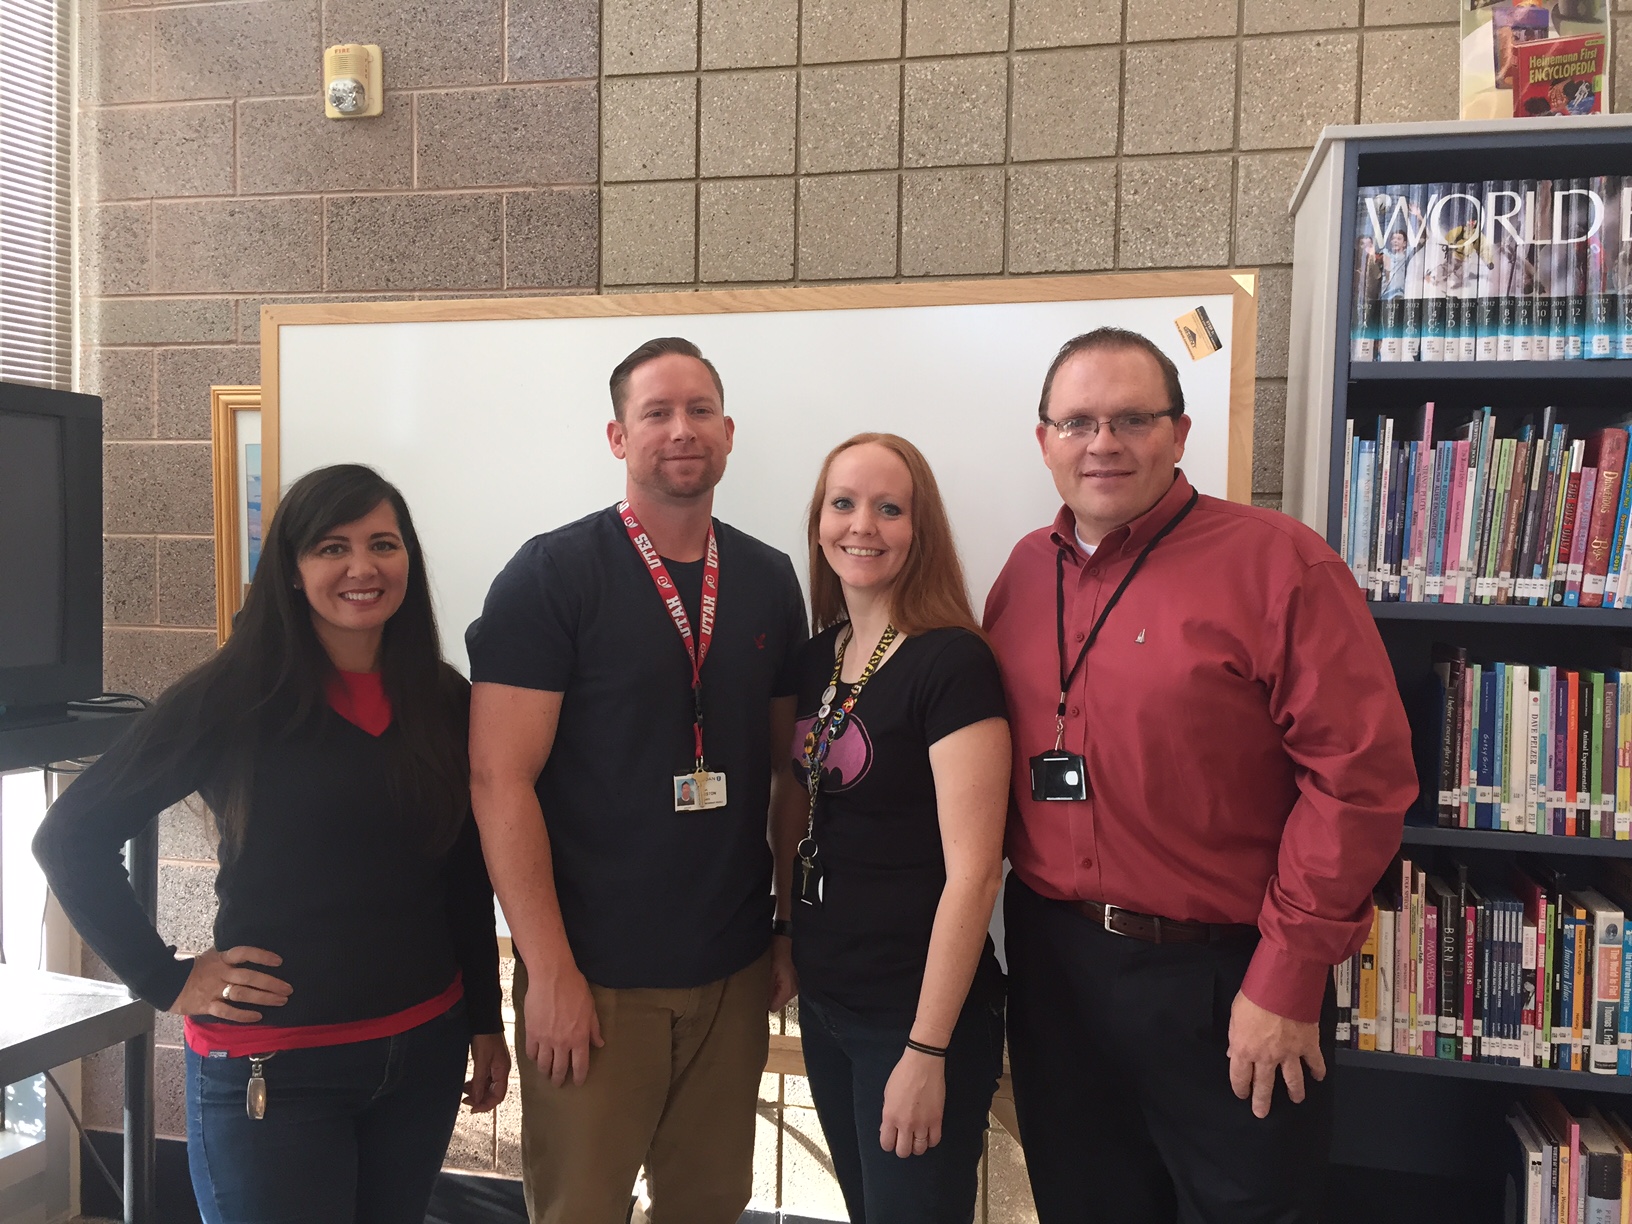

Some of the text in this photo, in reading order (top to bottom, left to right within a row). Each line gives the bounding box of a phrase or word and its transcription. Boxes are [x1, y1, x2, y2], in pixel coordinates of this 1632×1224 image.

[1530, 47, 1598, 68] Heinemann First
[1529, 60, 1596, 84] ENCYCLOPEDIA
[1364, 190, 1605, 249] WORLD
[1450, 311, 1454, 320] 5
[1485, 310, 1490, 318] 7
[1522, 309, 1528, 317] 9
[1536, 309, 1546, 317] 10
[1571, 308, 1580, 316] 12
[1597, 307, 1606, 315] 13
[1388, 320, 1394, 328] B
[1448, 320, 1456, 328] D
[1503, 318, 1510, 326] G
[1584, 480, 1594, 500] WHEN
[1511, 499, 1519, 518] Pioneers
[1582, 500, 1591, 510] DO
[1560, 482, 1578, 552] FOR BOYS ONLY
[1580, 512, 1590, 527] FISH
[1361, 530, 1368, 541] OF
[1616, 534, 1624, 554] Edition
[634, 532, 662, 570] UTES
[707, 535, 718, 568] UTES
[666, 596, 691, 638] UTAH
[702, 594, 716, 636] UTAH
[1446, 700, 1455, 718] before
[1605, 691, 1614, 729] Euthanasia
[1531, 714, 1539, 734] DAVE
[1481, 733, 1490, 755] Gutsy
[1530, 735, 1538, 765] PELZER
[1466, 937, 1474, 960] SILLY
[1610, 950, 1619, 960] The
[1426, 939, 1435, 990] MASS MEDIA
[1443, 927, 1455, 1014] BORN DIGIT
[1562, 946, 1573, 1002] American Values
[1609, 960, 1619, 978] World
[1608, 985, 1617, 996] Flat
[1603, 1006, 1615, 1028] Thomas
